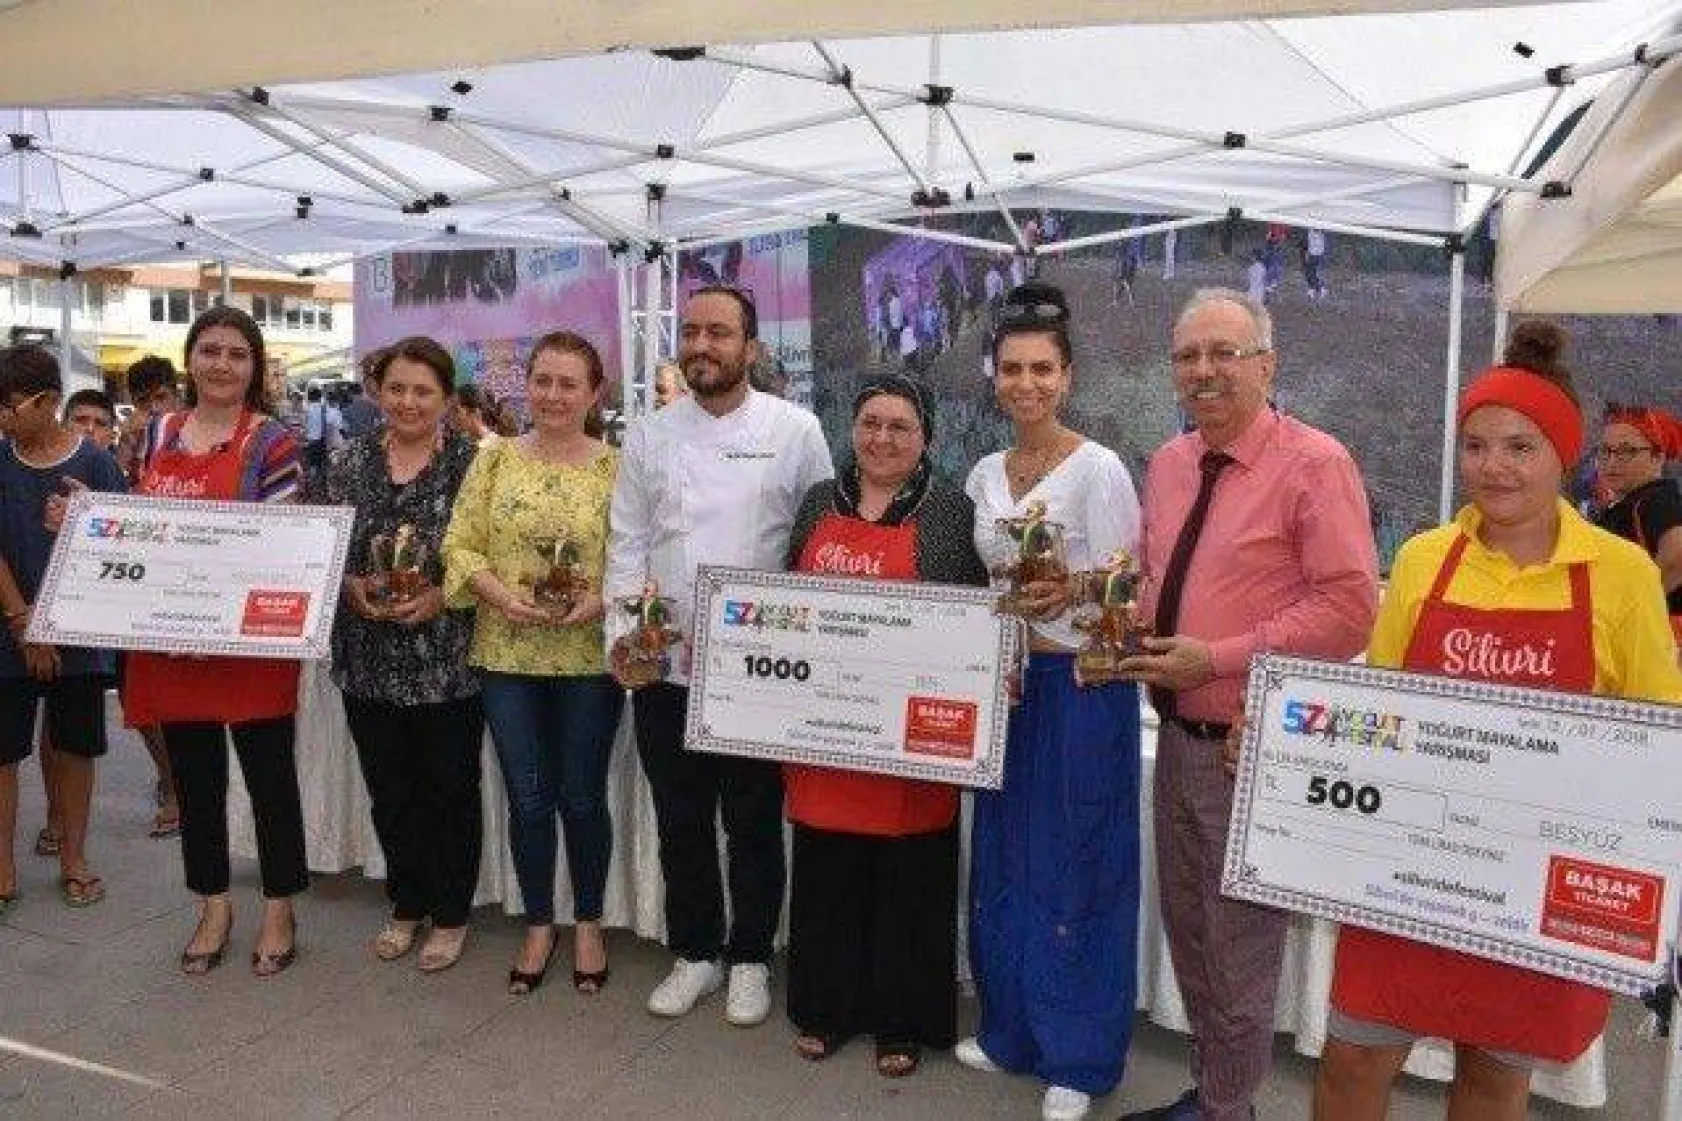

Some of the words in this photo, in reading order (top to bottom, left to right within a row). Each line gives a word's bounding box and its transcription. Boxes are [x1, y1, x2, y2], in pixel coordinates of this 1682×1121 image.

[99, 562, 146, 581] 750
[813, 543, 885, 574] Silivri
[744, 654, 811, 682] 1000
[1443, 628, 1556, 677] Silivri
[1415, 741, 1491, 764] YARIŞMASI
[1417, 719, 1475, 742] YOĞURT
[1476, 728, 1559, 756] MAYALAMA
[1306, 775, 1382, 815] 500
[1565, 869, 1642, 902] BAŞAK
